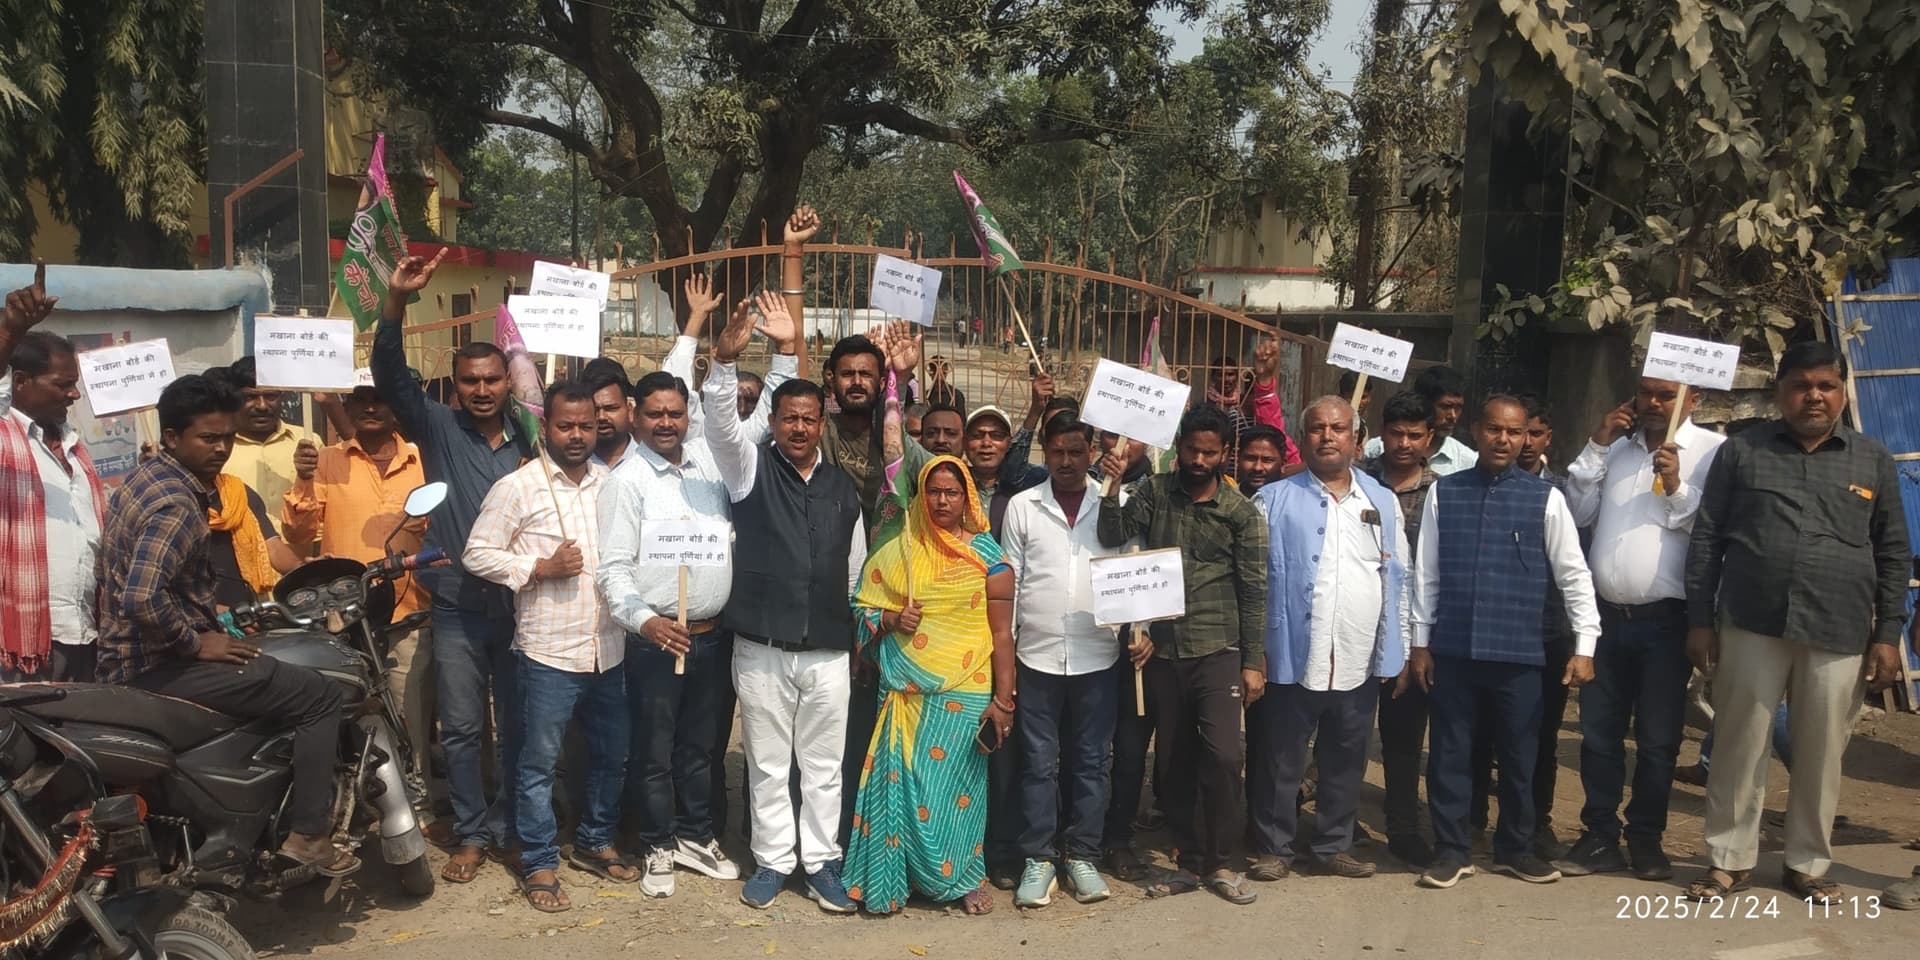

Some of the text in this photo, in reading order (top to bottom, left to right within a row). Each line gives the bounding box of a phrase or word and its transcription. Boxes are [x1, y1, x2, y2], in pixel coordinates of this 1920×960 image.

[269, 331, 329, 341] मखाना बोर्ड की
[262, 348, 287, 356] स्थापना
[329, 349, 337, 358] हो
[1344, 340, 1397, 359] मखाना बोर्ड की
[1662, 341, 1724, 359] मखाना बोर्ड की
[93, 353, 155, 373] मखाना बोर्ड की
[1332, 353, 1357, 364] स्थापना
[1392, 368, 1399, 376] हो
[1650, 357, 1677, 366] स्थापना
[1718, 370, 1727, 378] हो
[90, 379, 117, 390] स्थापना
[160, 369, 167, 378] हो
[1109, 376, 1165, 399] मखाना बोर्ड की
[1097, 390, 1122, 403] स्थापना
[1158, 409, 1166, 417] हो
[658, 533, 718, 543] मखाना बोर्ड की
[648, 552, 675, 560] स्थापना
[717, 552, 724, 561] हो
[1107, 564, 1160, 580] मखाना बोर्ड की
[1101, 588, 1125, 597] स्थापना
